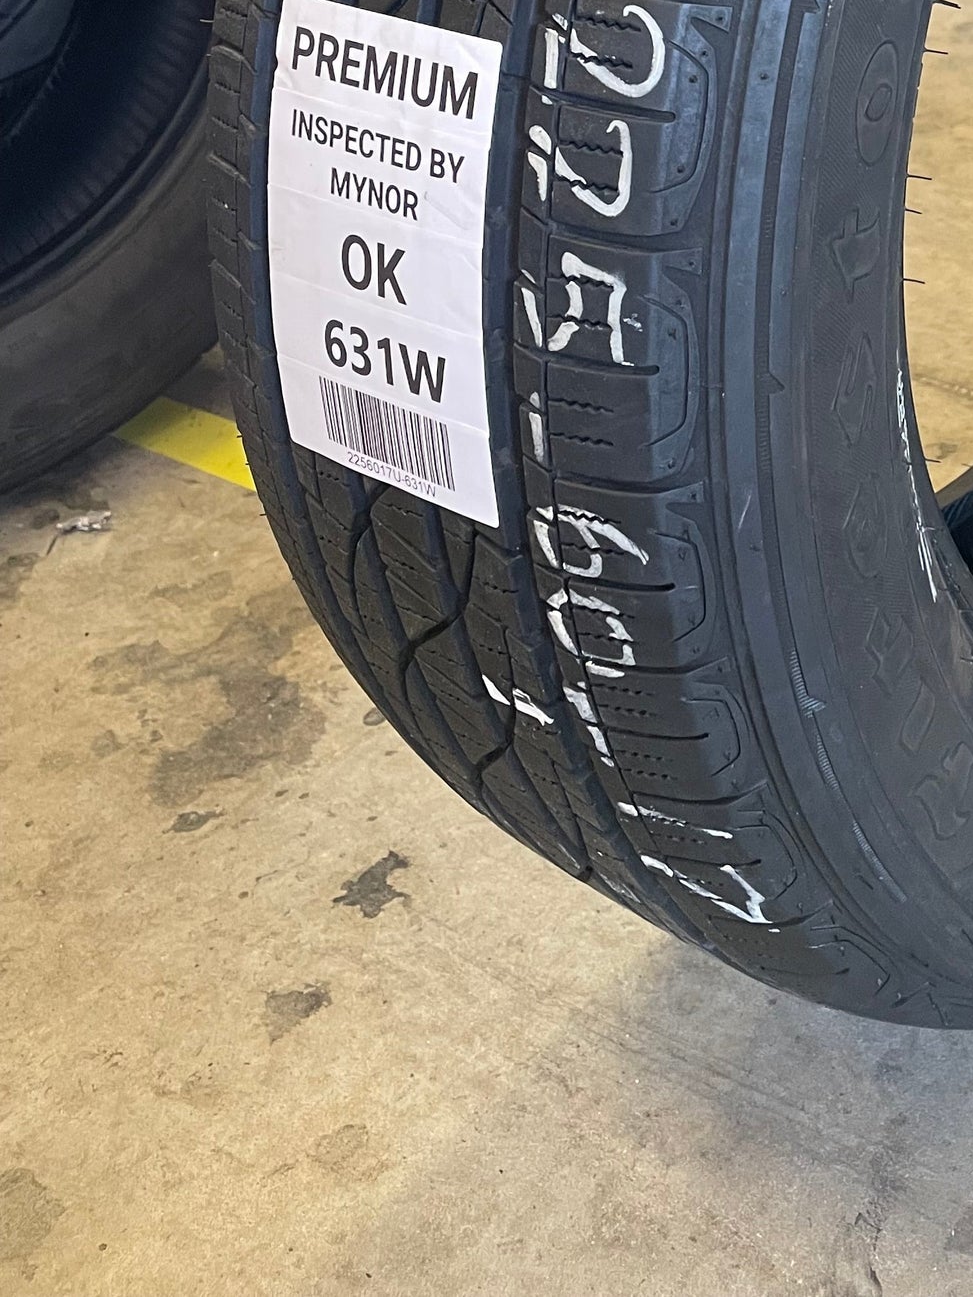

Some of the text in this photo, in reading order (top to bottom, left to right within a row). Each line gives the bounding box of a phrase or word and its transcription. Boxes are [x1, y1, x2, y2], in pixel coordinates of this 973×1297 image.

[291, 26, 479, 120] PREMIUM
[291, 109, 465, 184] INSPECTED BY
[330, 167, 419, 221] MYNOR
[341, 234, 407, 306] OK
[324, 319, 446, 404] 631W
[347, 451, 436, 498] 2256017U-631W
